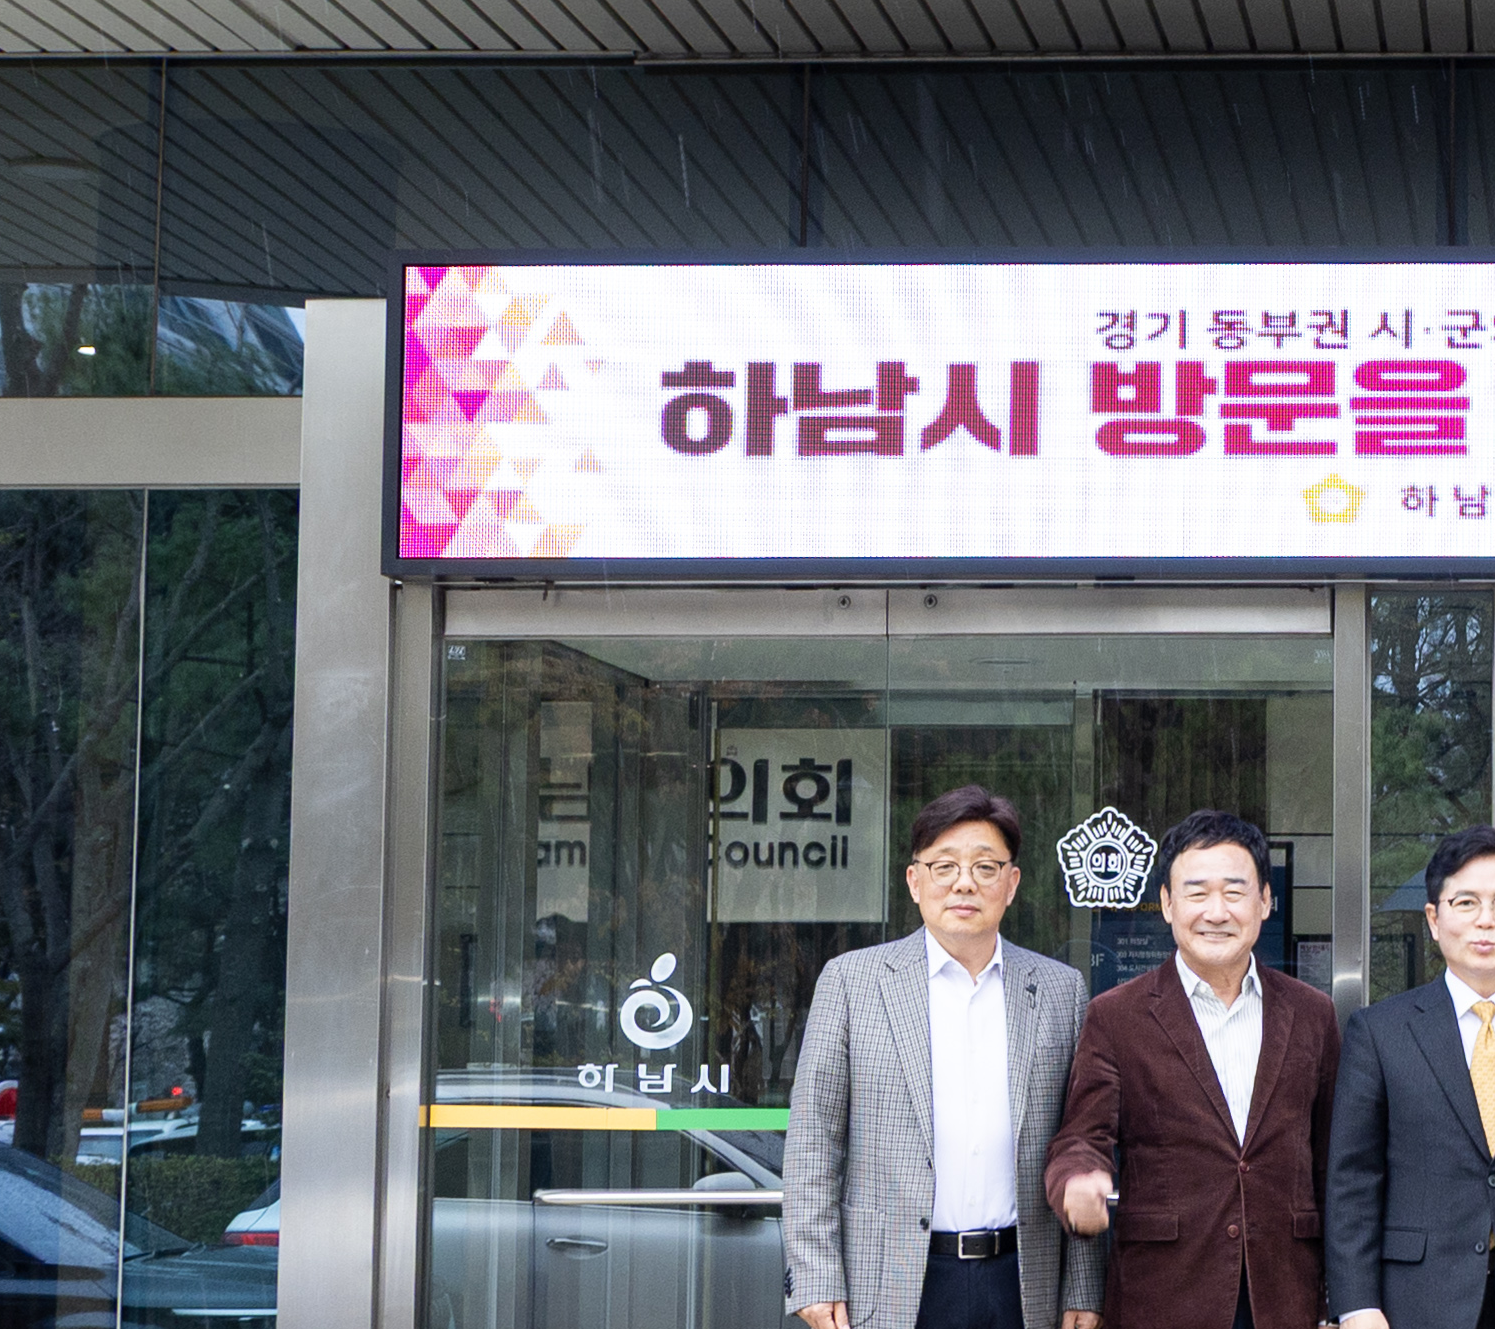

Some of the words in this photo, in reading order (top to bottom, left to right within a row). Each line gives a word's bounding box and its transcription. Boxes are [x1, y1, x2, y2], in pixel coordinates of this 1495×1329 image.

[1095, 308, 1188, 350] 경기
[1207, 308, 1351, 350] 동부권
[659, 357, 1040, 458] 하남시
[1089, 357, 1471, 458] 방문을
[707, 834, 849, 870] ouncil
[1091, 852, 1122, 874] 의회
[576, 1062, 730, 1094] 하남시
